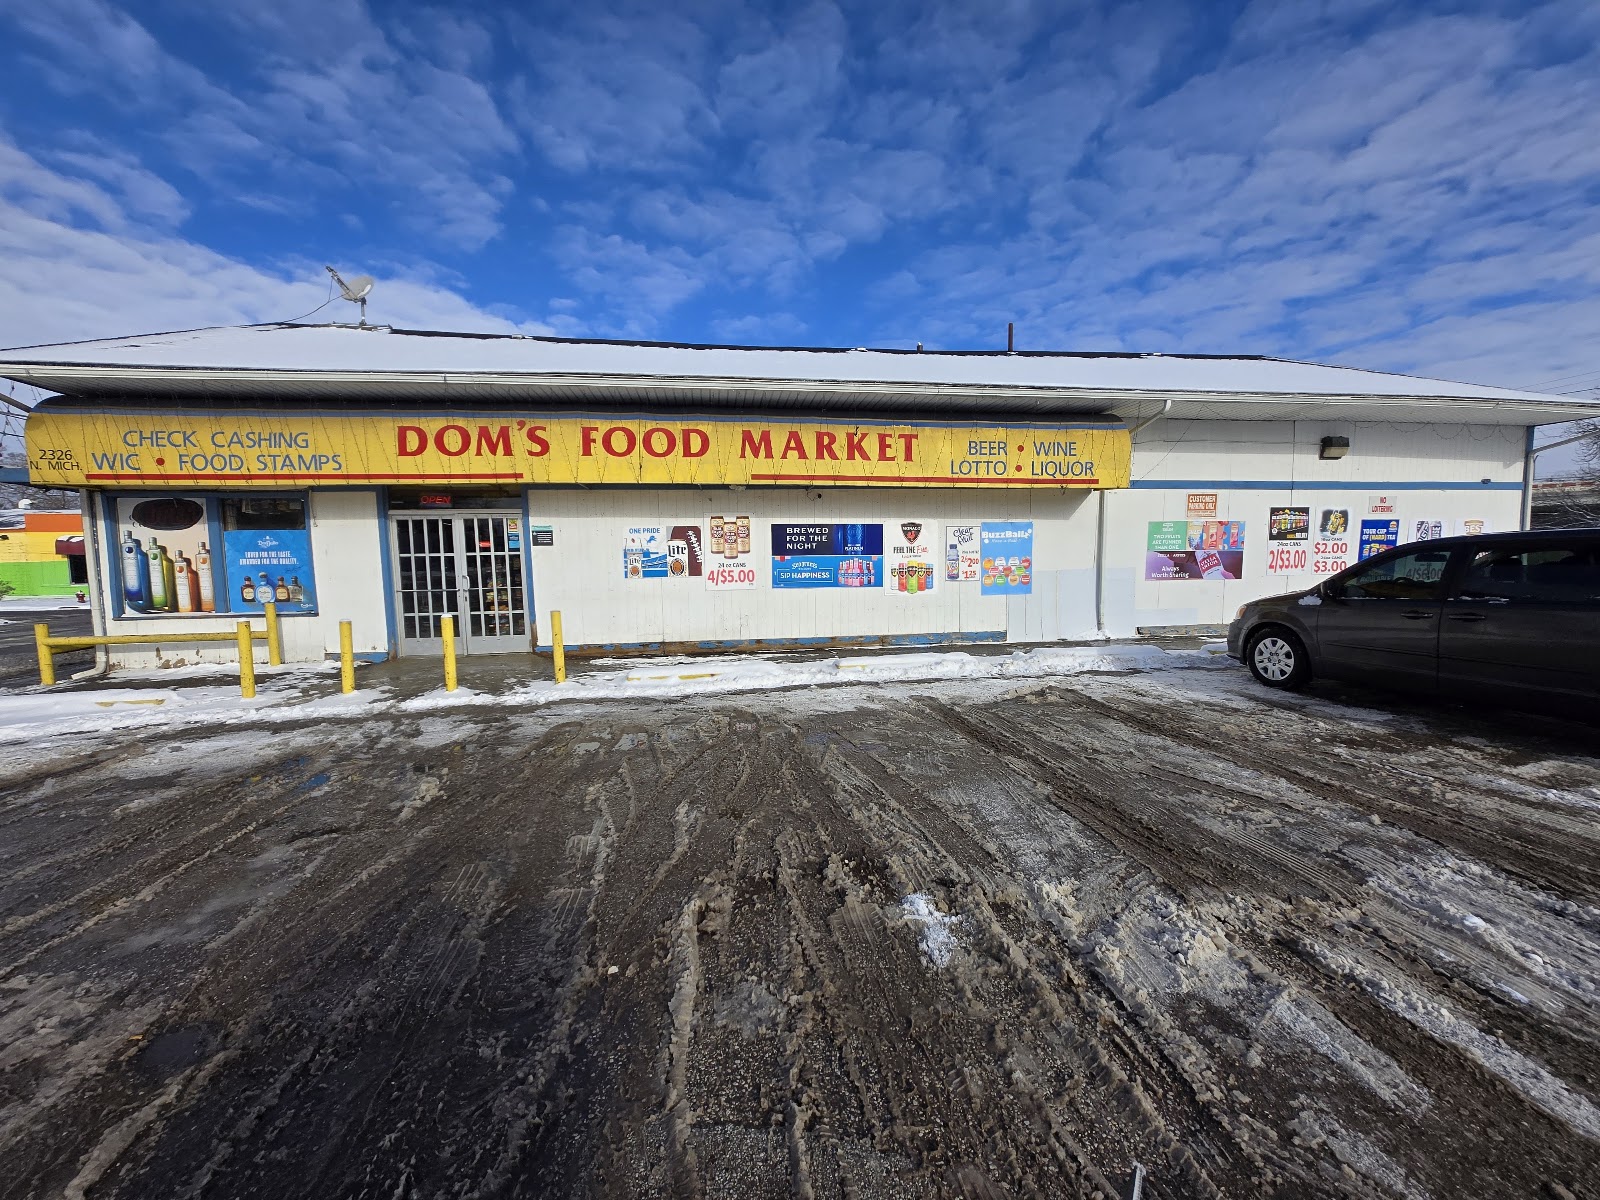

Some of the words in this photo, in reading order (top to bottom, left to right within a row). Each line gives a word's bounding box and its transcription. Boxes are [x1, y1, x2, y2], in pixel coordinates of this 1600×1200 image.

[122, 430, 198, 448] CHECK
[211, 432, 309, 449] CASHING
[397, 420, 550, 457] DOM'S
[581, 426, 710, 457] FOOD
[739, 429, 918, 462] MARKET
[39, 449, 73, 461] 2326
[968, 441, 1008, 456] BEER
[1034, 441, 1077, 457] WINE
[29, 460, 42, 470] N.
[48, 461, 83, 471] MICH.
[91, 452, 141, 471] WIC
[179, 453, 244, 471] FOOD
[257, 454, 342, 471] STAMPS
[951, 459, 1007, 476] LOTTO
[1031, 461, 1095, 478] LIQUOR
[420, 495, 452, 504] OPEN
[1189, 495, 1216, 503] CUSTOMER
[1465, 525, 1484, 533] BEST
[668, 545, 687, 558] Lite
[1314, 542, 1348, 555] $2.00
[1269, 548, 1307, 573] 2/$3.00
[1314, 560, 1347, 573] $3.00
[780, 571, 790, 579] SIP
[791, 571, 830, 579] HAPPINESS
[1161, 565, 1180, 573] Always
[707, 569, 755, 586] 4/$5.00
